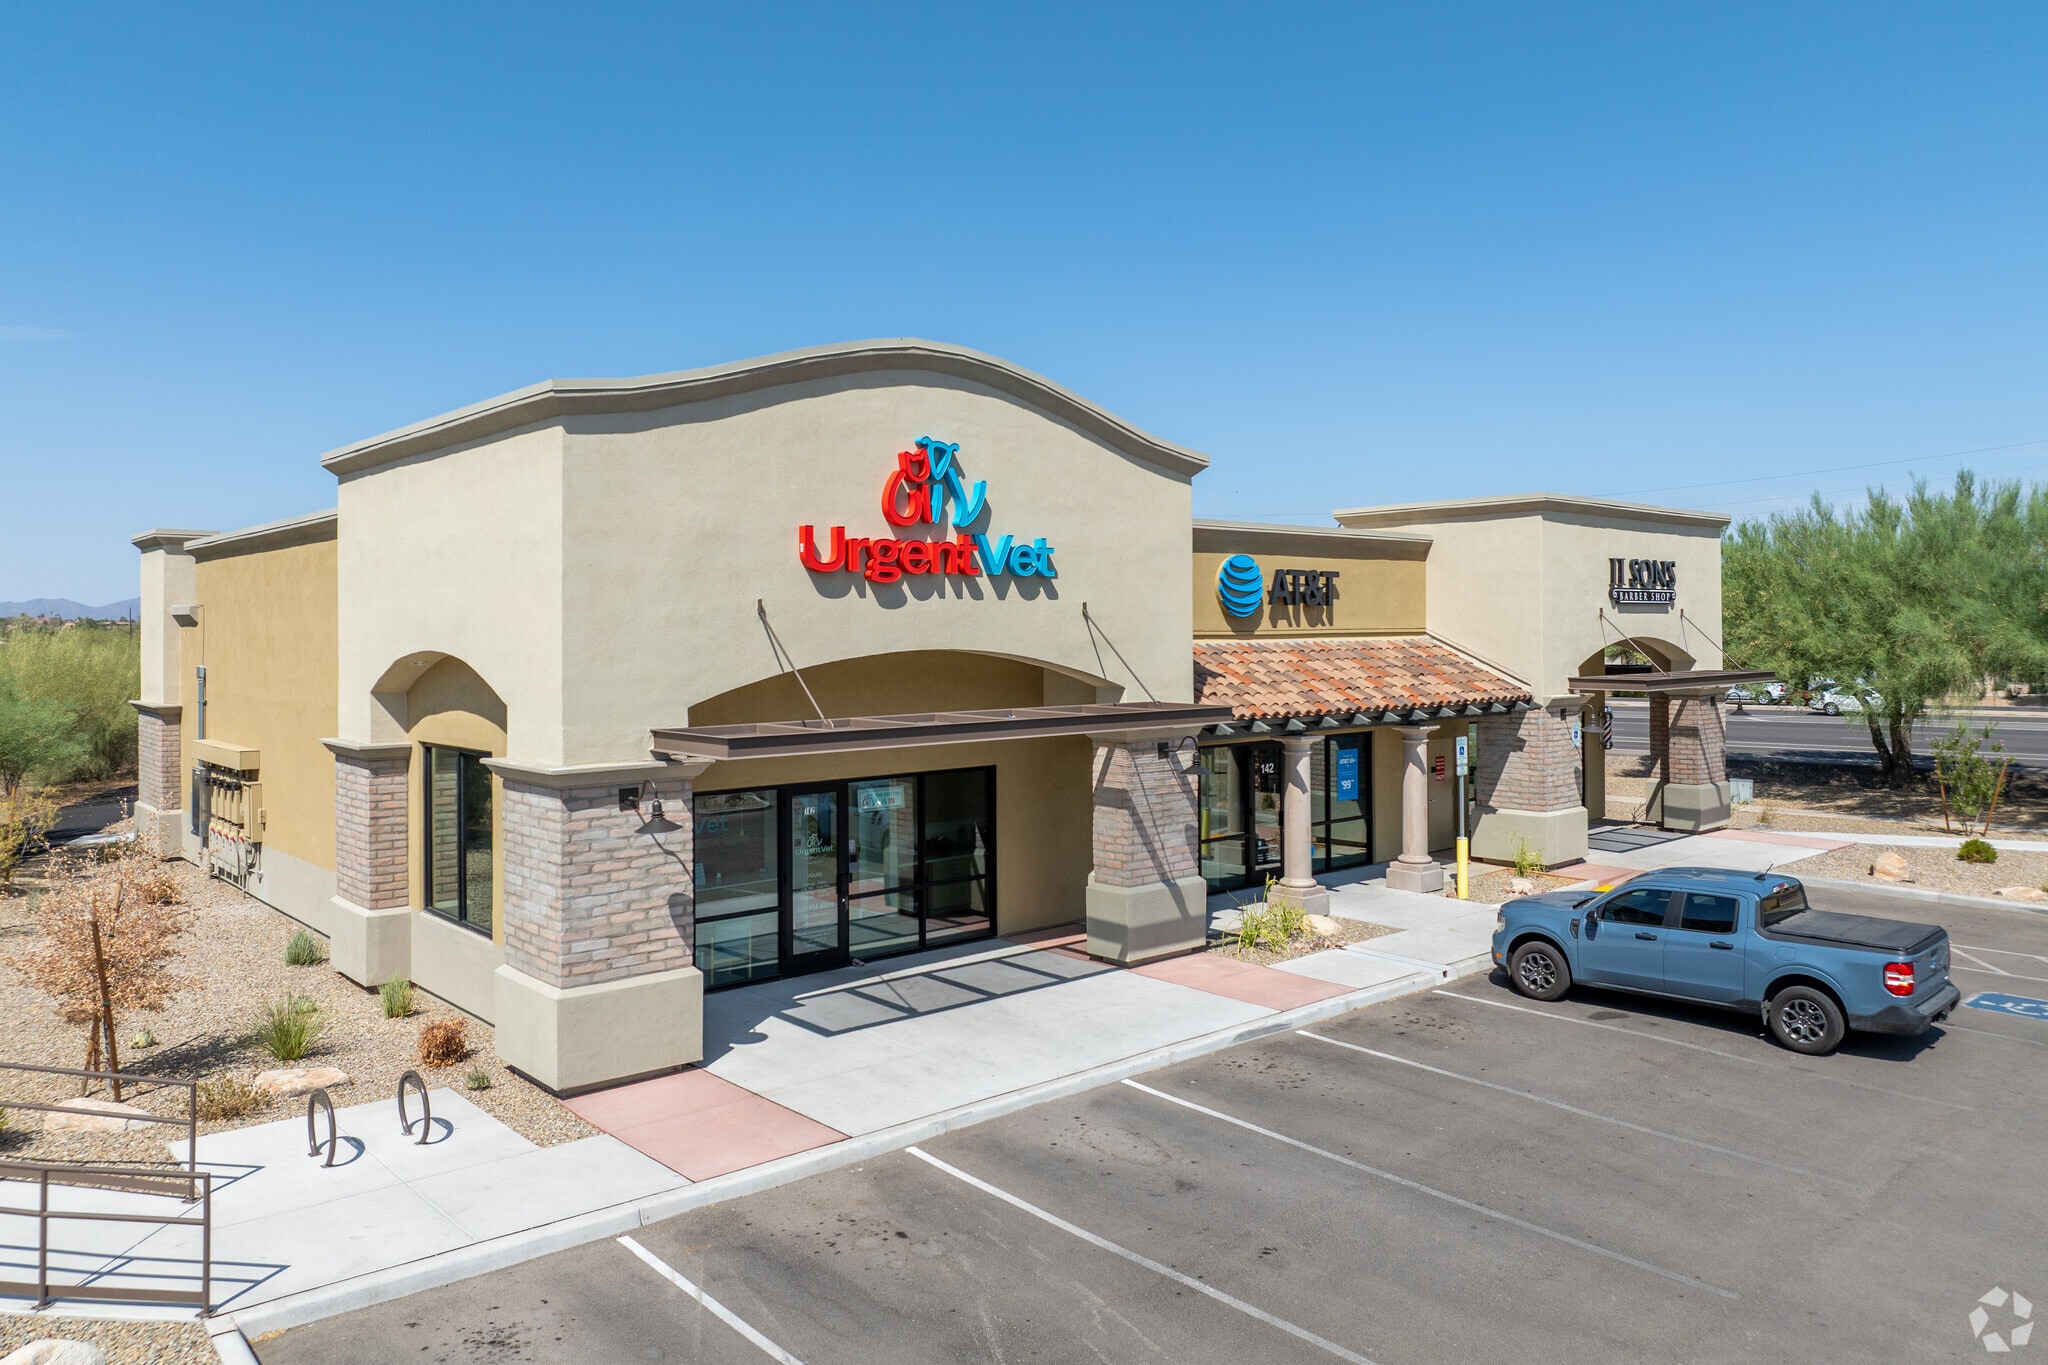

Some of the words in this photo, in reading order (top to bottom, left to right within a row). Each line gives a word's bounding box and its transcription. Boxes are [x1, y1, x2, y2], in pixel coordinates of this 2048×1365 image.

[1628, 558, 1677, 589] SONS
[1268, 569, 1340, 606] AT&T
[1619, 591, 1648, 601] BARBER
[1651, 592, 1670, 602] SHOP
[1260, 762, 1274, 774] 142
